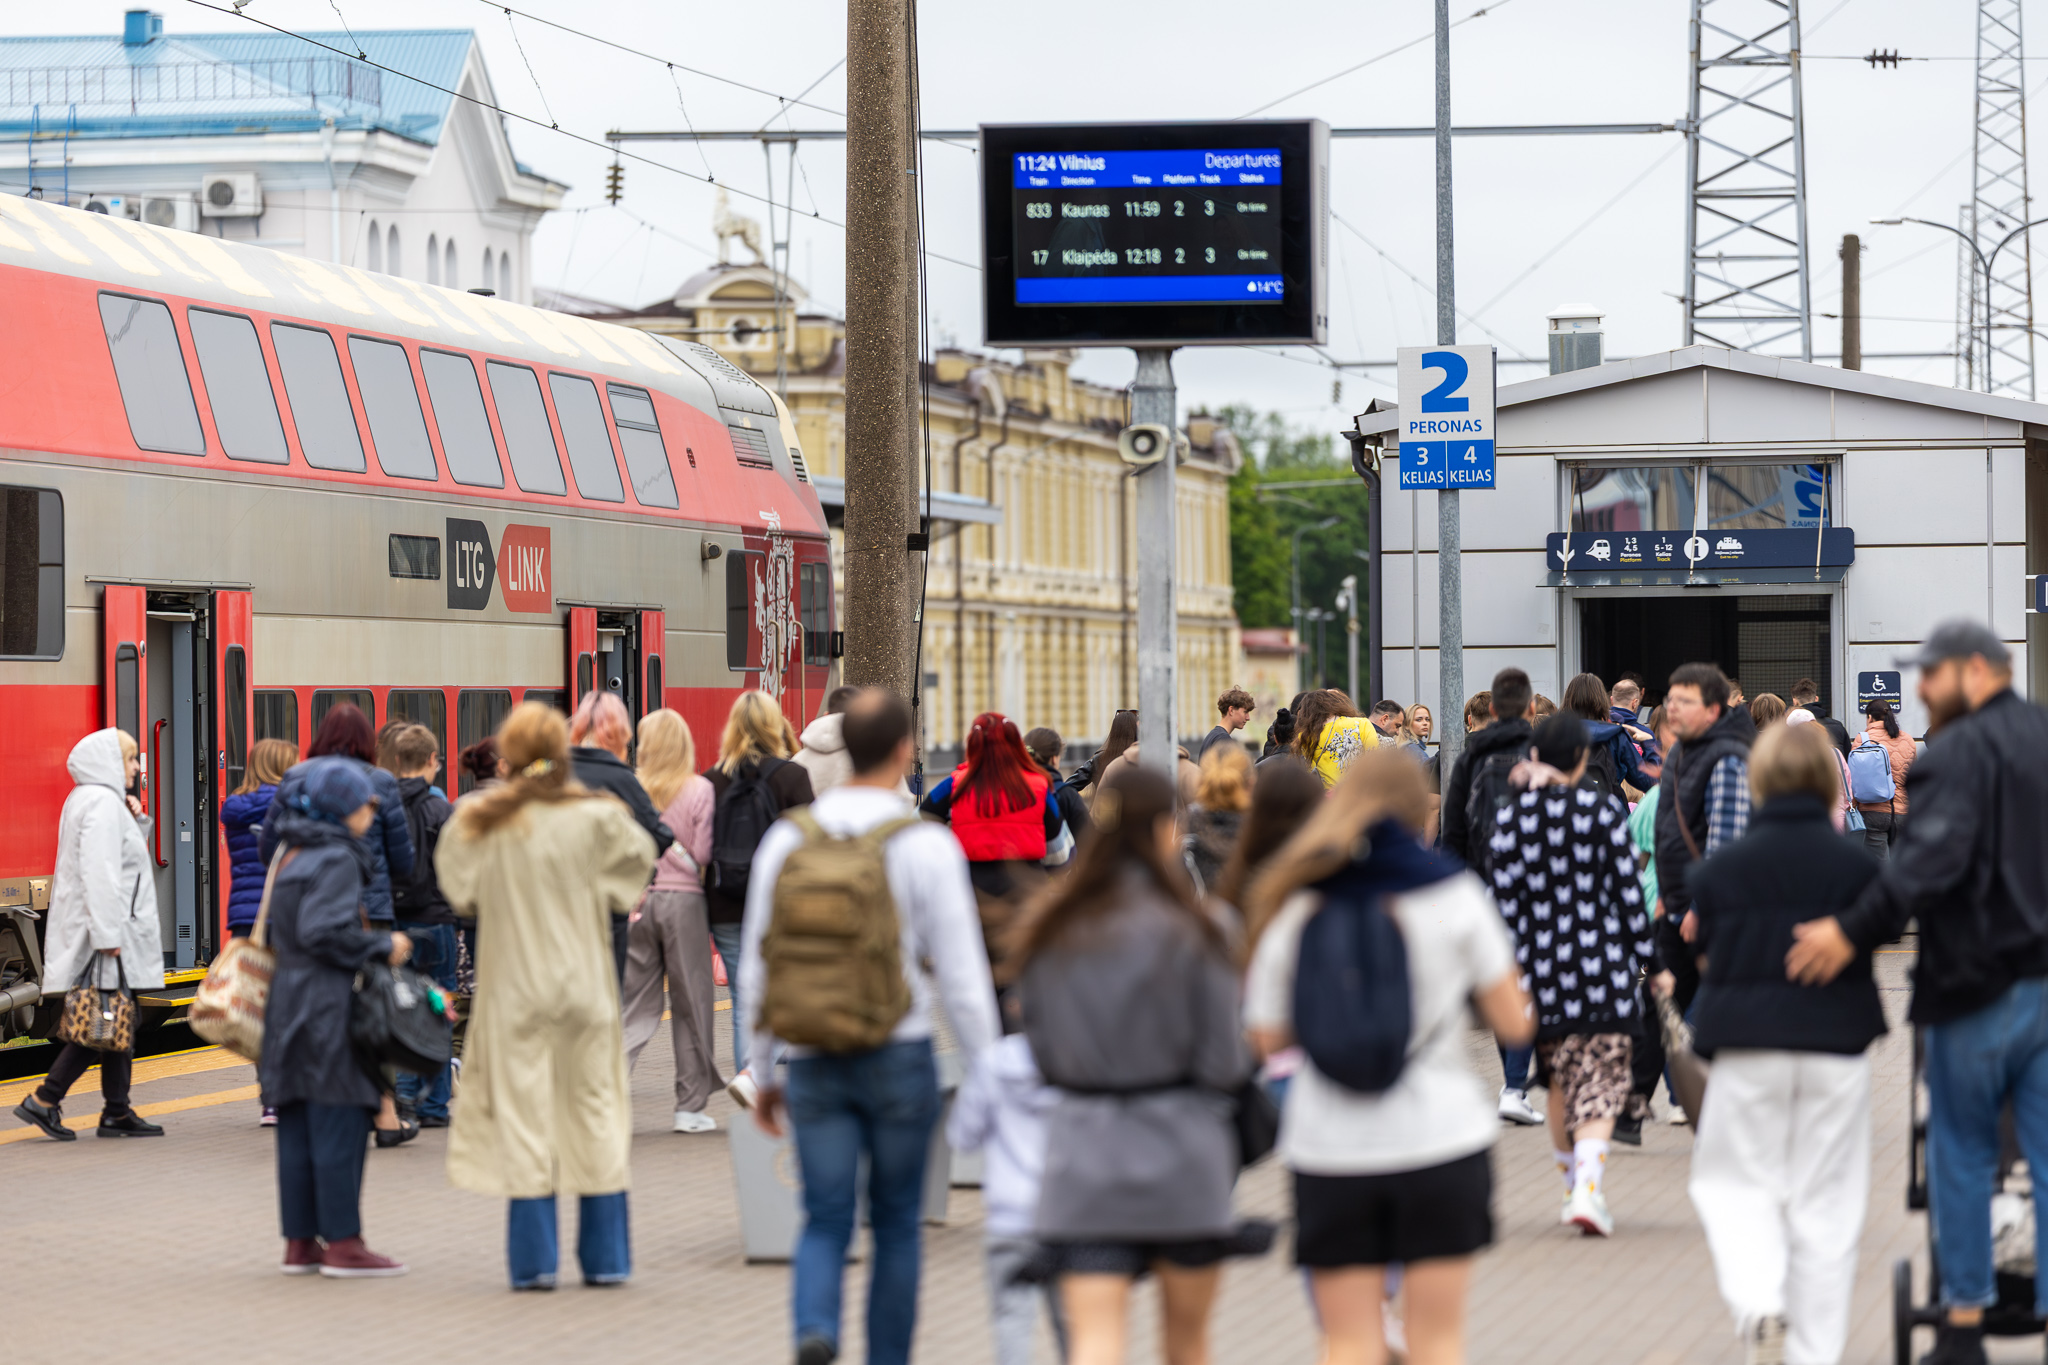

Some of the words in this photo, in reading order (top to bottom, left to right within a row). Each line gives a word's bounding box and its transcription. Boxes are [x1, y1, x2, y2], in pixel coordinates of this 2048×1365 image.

[1017, 154, 1057, 172] 11:24
[1058, 153, 1106, 171] Vilnius
[1205, 152, 1282, 170] Departures
[1029, 175, 1050, 186] Train
[1060, 175, 1096, 186] Direction
[1131, 174, 1152, 185] Time
[1162, 173, 1197, 184] Platform
[1199, 173, 1221, 184] Track
[1238, 173, 1265, 183] Status
[1026, 202, 1052, 218] 833
[1061, 201, 1110, 218] Kaunas
[1123, 200, 1161, 217] 11:59
[1173, 200, 1185, 217] 2
[1203, 199, 1216, 216] 3
[1031, 249, 1050, 266] 17
[1062, 248, 1119, 268] Klaipėda
[1125, 247, 1162, 265] 12:18
[1174, 247, 1186, 264] 2
[1204, 247, 1216, 264] 3
[1256, 280, 1285, 294] 14°C
[1421, 351, 1469, 413] 2
[1409, 419, 1483, 434] PERONAS
[1416, 447, 1429, 466] 3
[1463, 445, 1478, 464] 4
[1402, 470, 1444, 484] KELIAS
[1449, 468, 1492, 483] KELIAS
[455, 540, 485, 590] LTG
[508, 544, 546, 593] LINK
